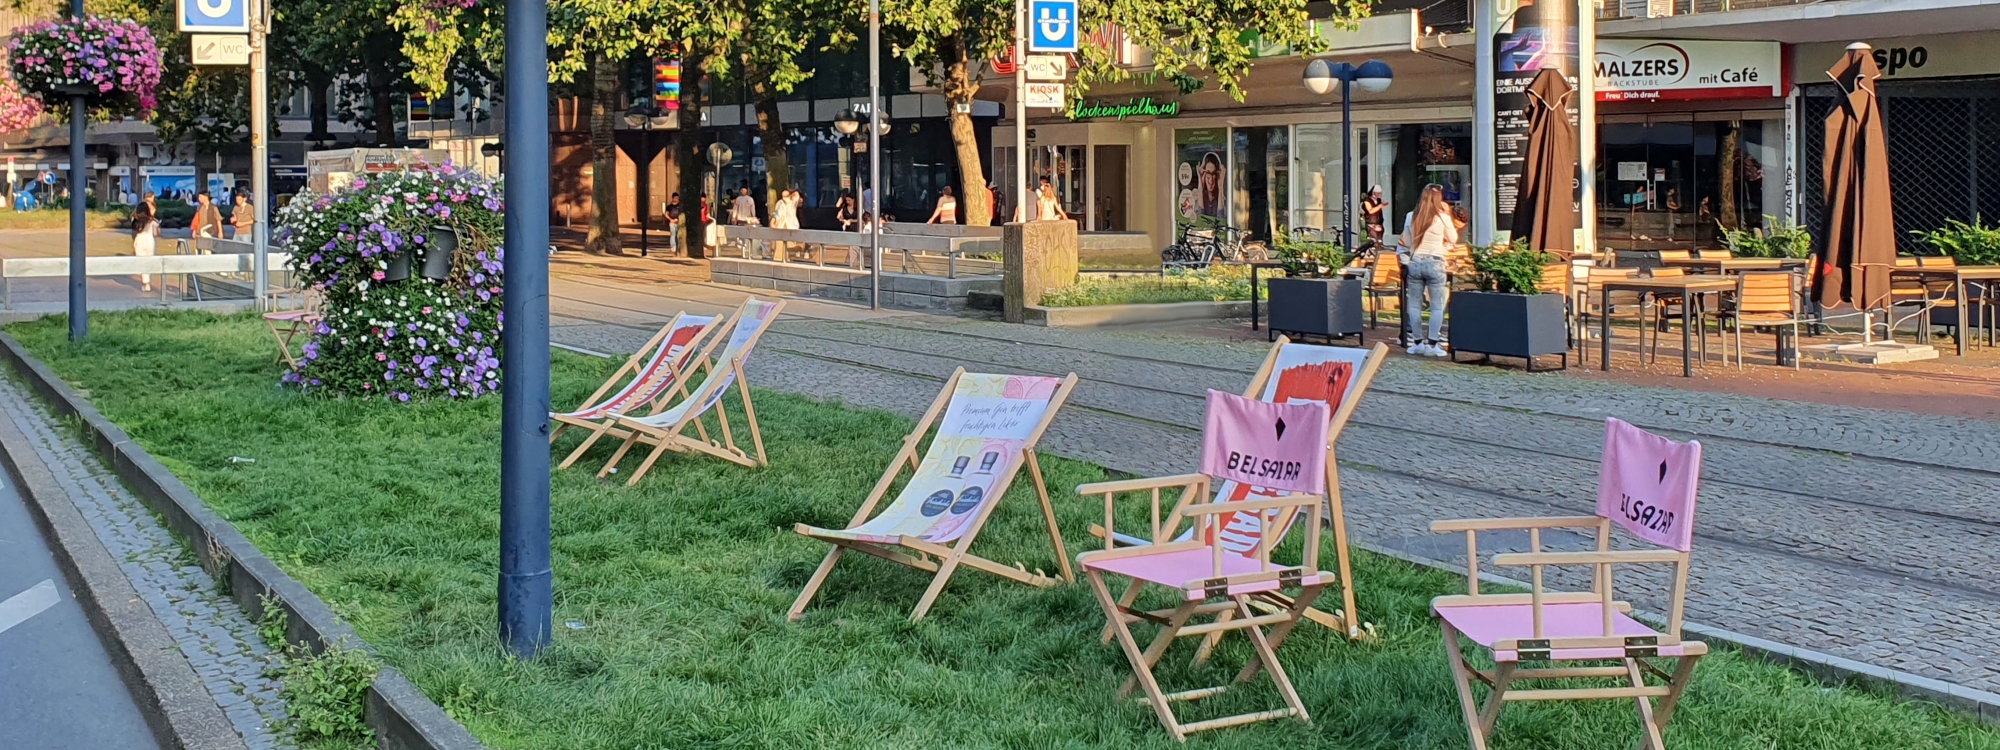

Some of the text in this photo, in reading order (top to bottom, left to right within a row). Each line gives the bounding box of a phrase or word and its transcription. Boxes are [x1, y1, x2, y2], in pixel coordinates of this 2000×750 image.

[222, 45, 243, 54] WC
[1030, 62, 1045, 72] WC
[1593, 58, 1679, 78] MALZERS
[1699, 67, 1759, 84] mit Café
[1607, 79, 1660, 87] BACKSTUBE
[1030, 85, 1059, 94] KIOSK
[1075, 97, 1177, 121] lockenspielhaus
